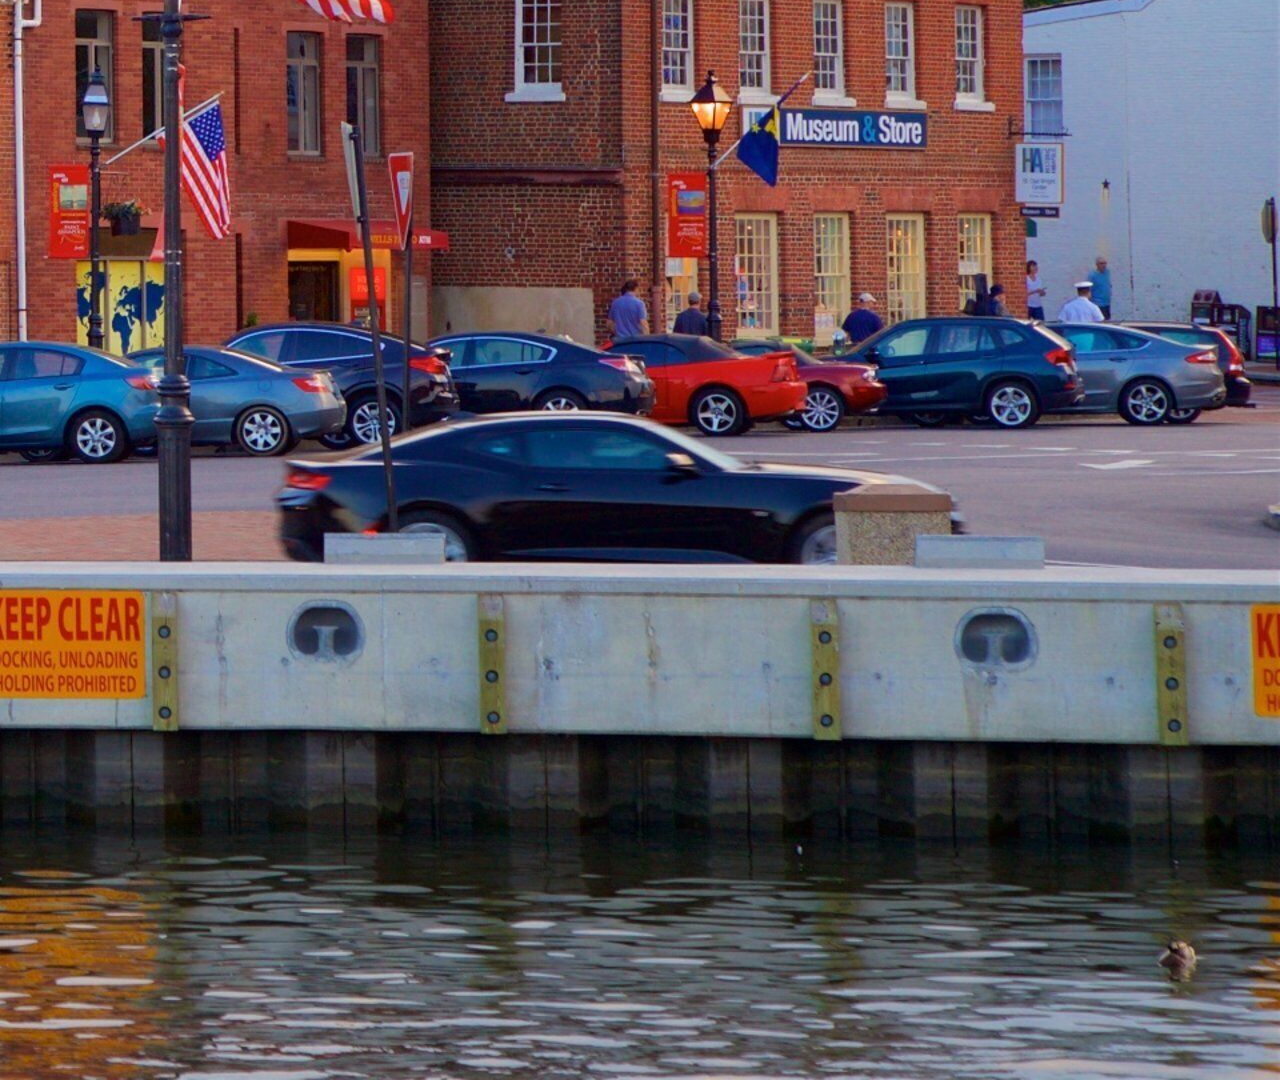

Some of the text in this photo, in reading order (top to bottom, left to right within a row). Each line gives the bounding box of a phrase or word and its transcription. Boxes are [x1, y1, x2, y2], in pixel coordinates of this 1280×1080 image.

[786, 113, 923, 145] Museum & Store
[57, 596, 141, 642] CLEAR
[58, 651, 138, 669] UNLOADING
[57, 675, 137, 693] PROHIBITED
